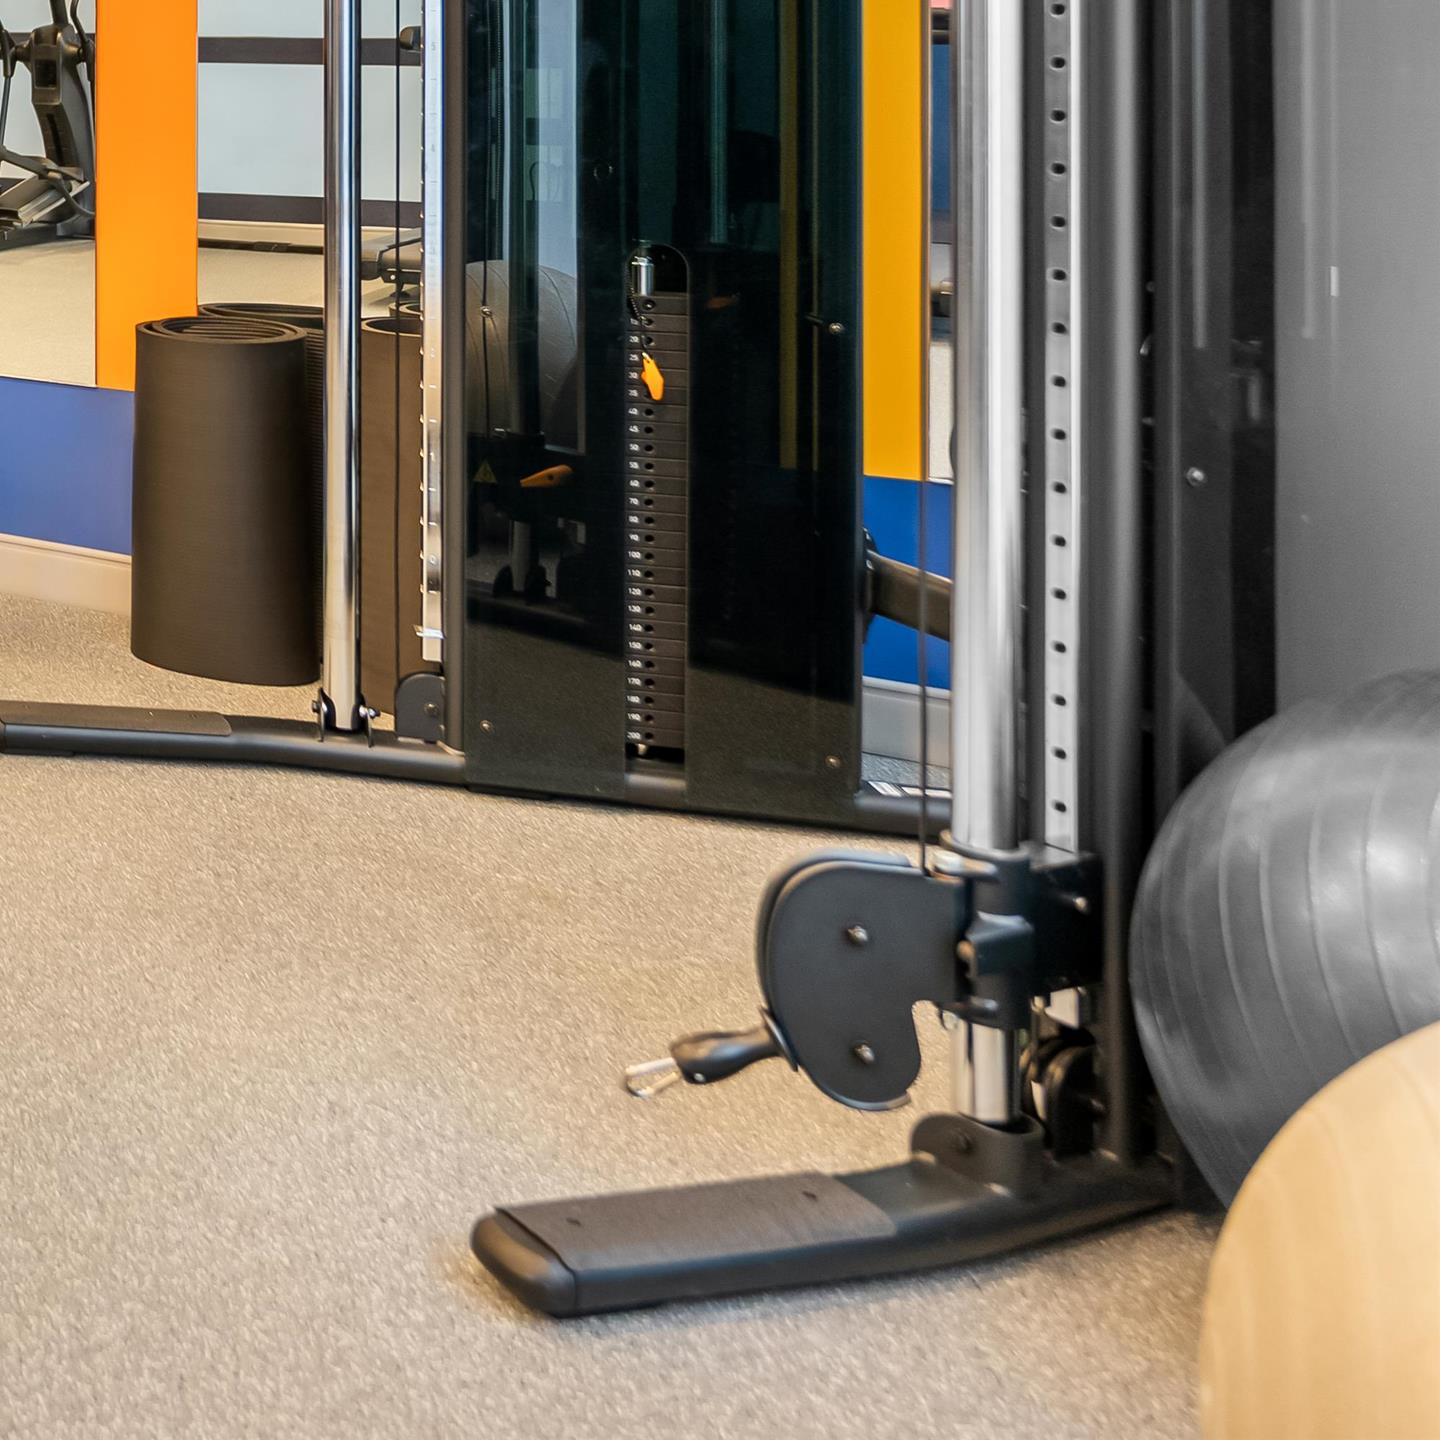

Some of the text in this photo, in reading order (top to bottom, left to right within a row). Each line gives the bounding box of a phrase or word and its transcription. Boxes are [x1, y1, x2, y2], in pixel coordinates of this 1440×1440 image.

[628, 550, 641, 560] 100
[627, 568, 641, 577] 110
[628, 587, 642, 596] 120
[628, 623, 642, 632] 140
